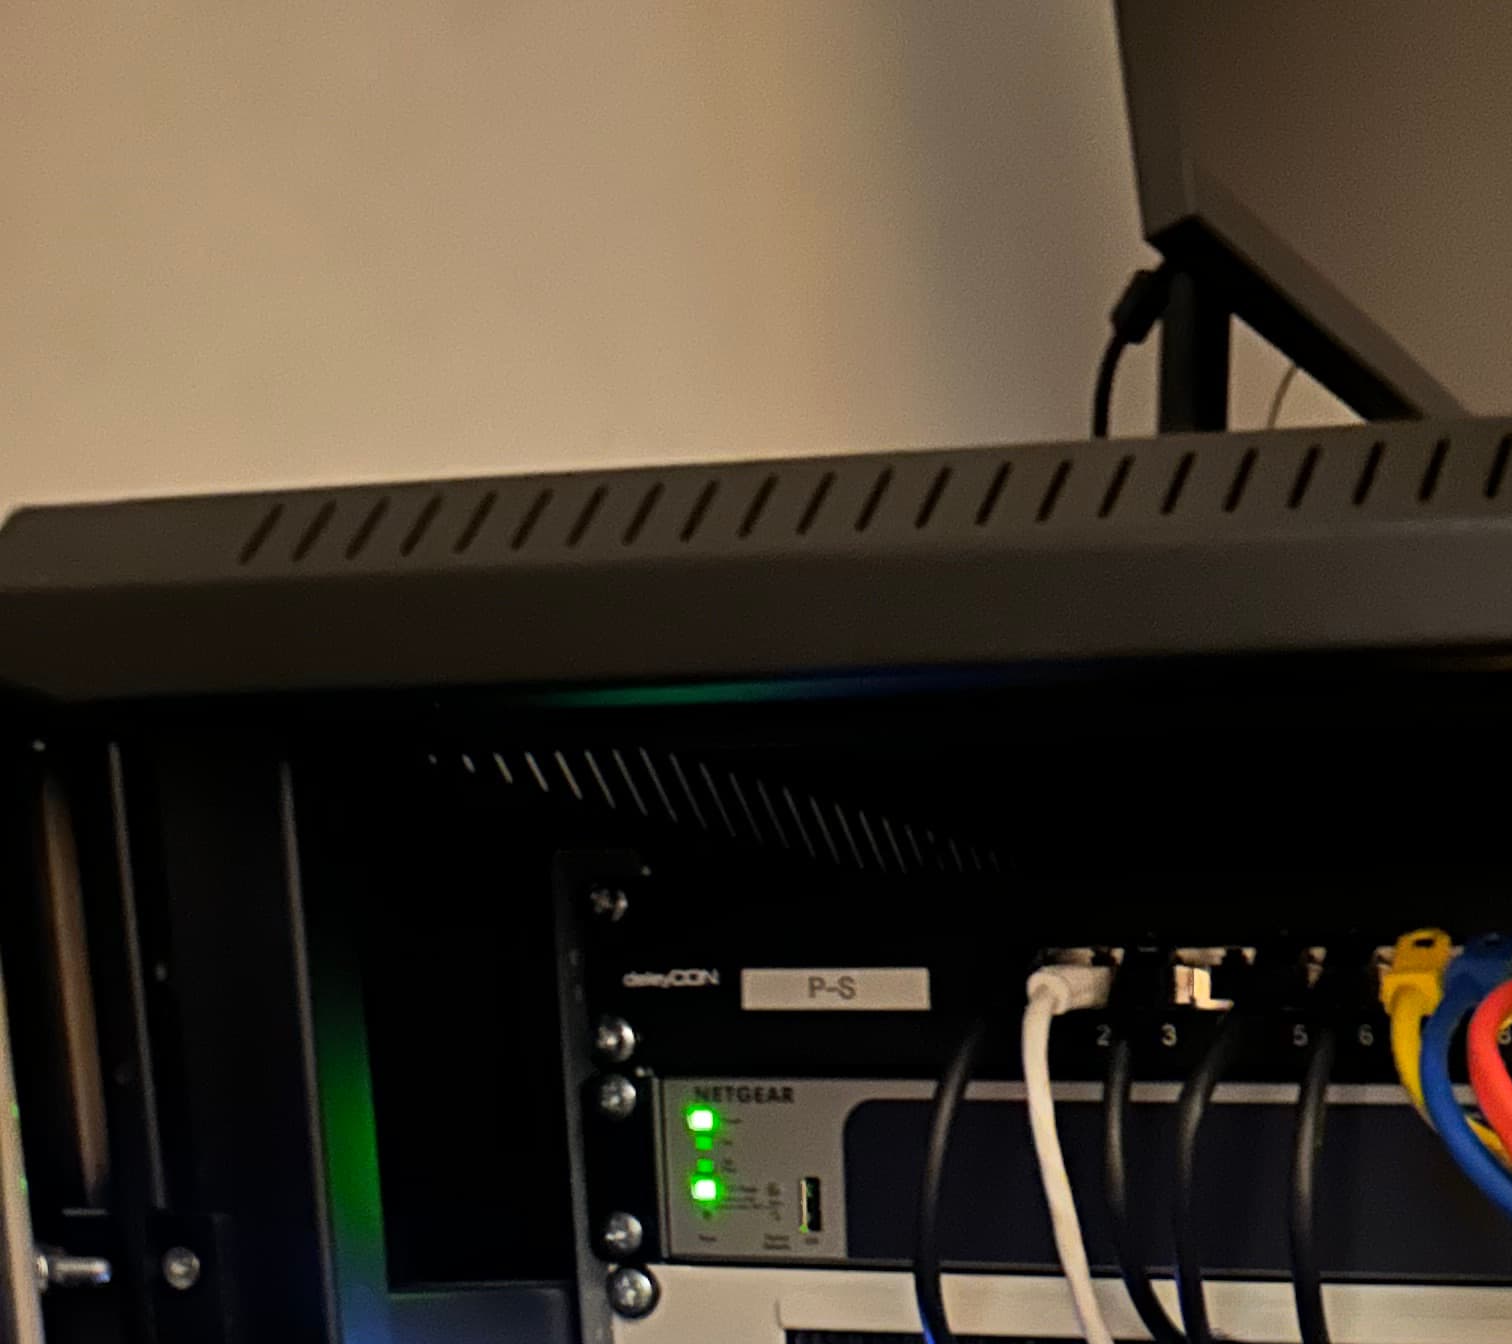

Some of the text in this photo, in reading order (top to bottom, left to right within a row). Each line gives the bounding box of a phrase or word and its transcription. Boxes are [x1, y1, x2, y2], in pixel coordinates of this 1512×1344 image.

[807, 976, 858, 1001] P-S
[1095, 1024, 1111, 1046] 2
[1161, 1023, 1178, 1047] 3
[1292, 1024, 1309, 1047] 5
[1357, 1024, 1374, 1047] 6
[693, 1086, 795, 1104] NETGEAR
